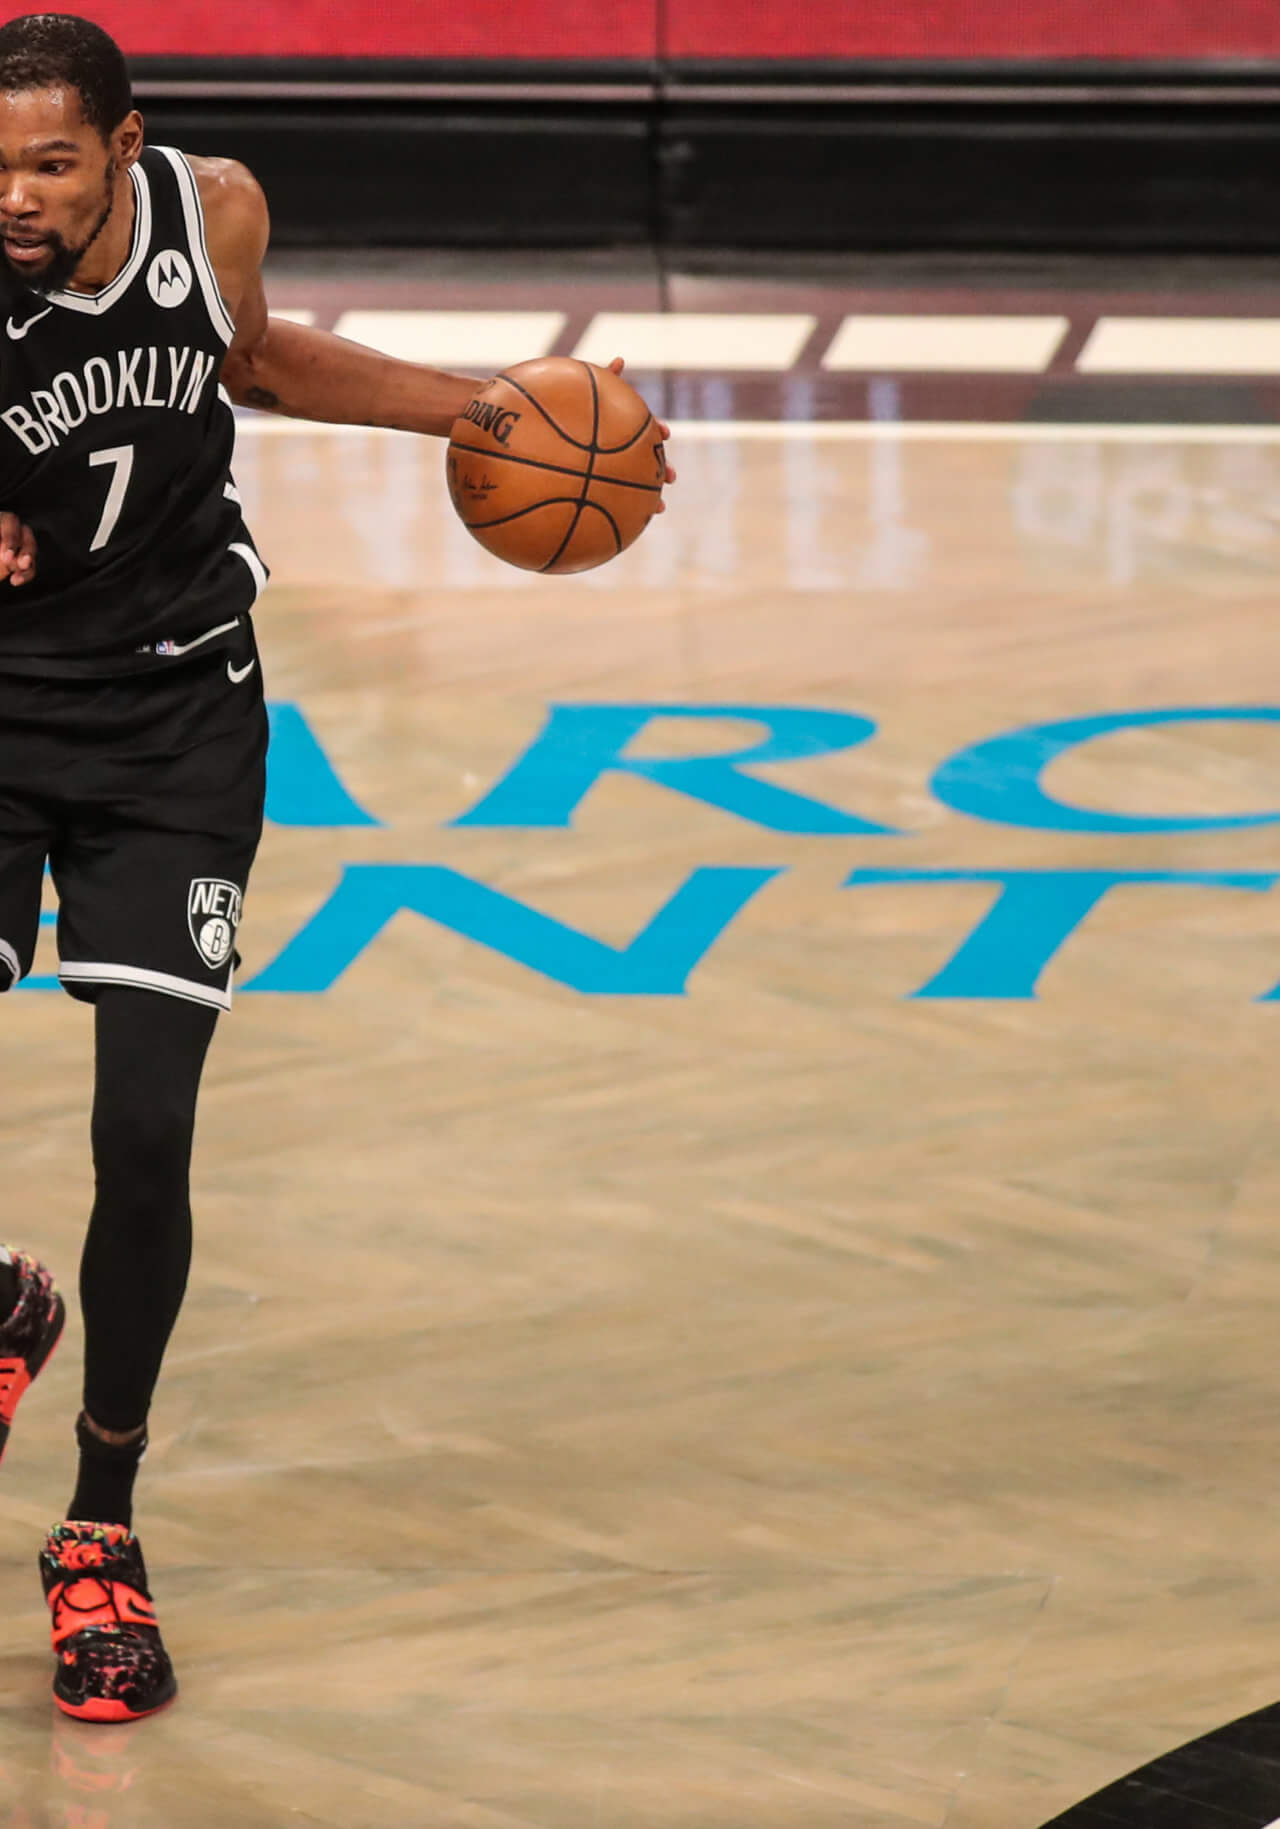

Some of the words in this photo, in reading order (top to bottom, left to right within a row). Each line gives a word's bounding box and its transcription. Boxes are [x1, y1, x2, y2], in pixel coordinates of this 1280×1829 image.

[0, 346, 215, 455] BROOKLYN
[459, 400, 522, 444] DING
[89, 444, 134, 552] 7
[191, 883, 241, 927] NETS
